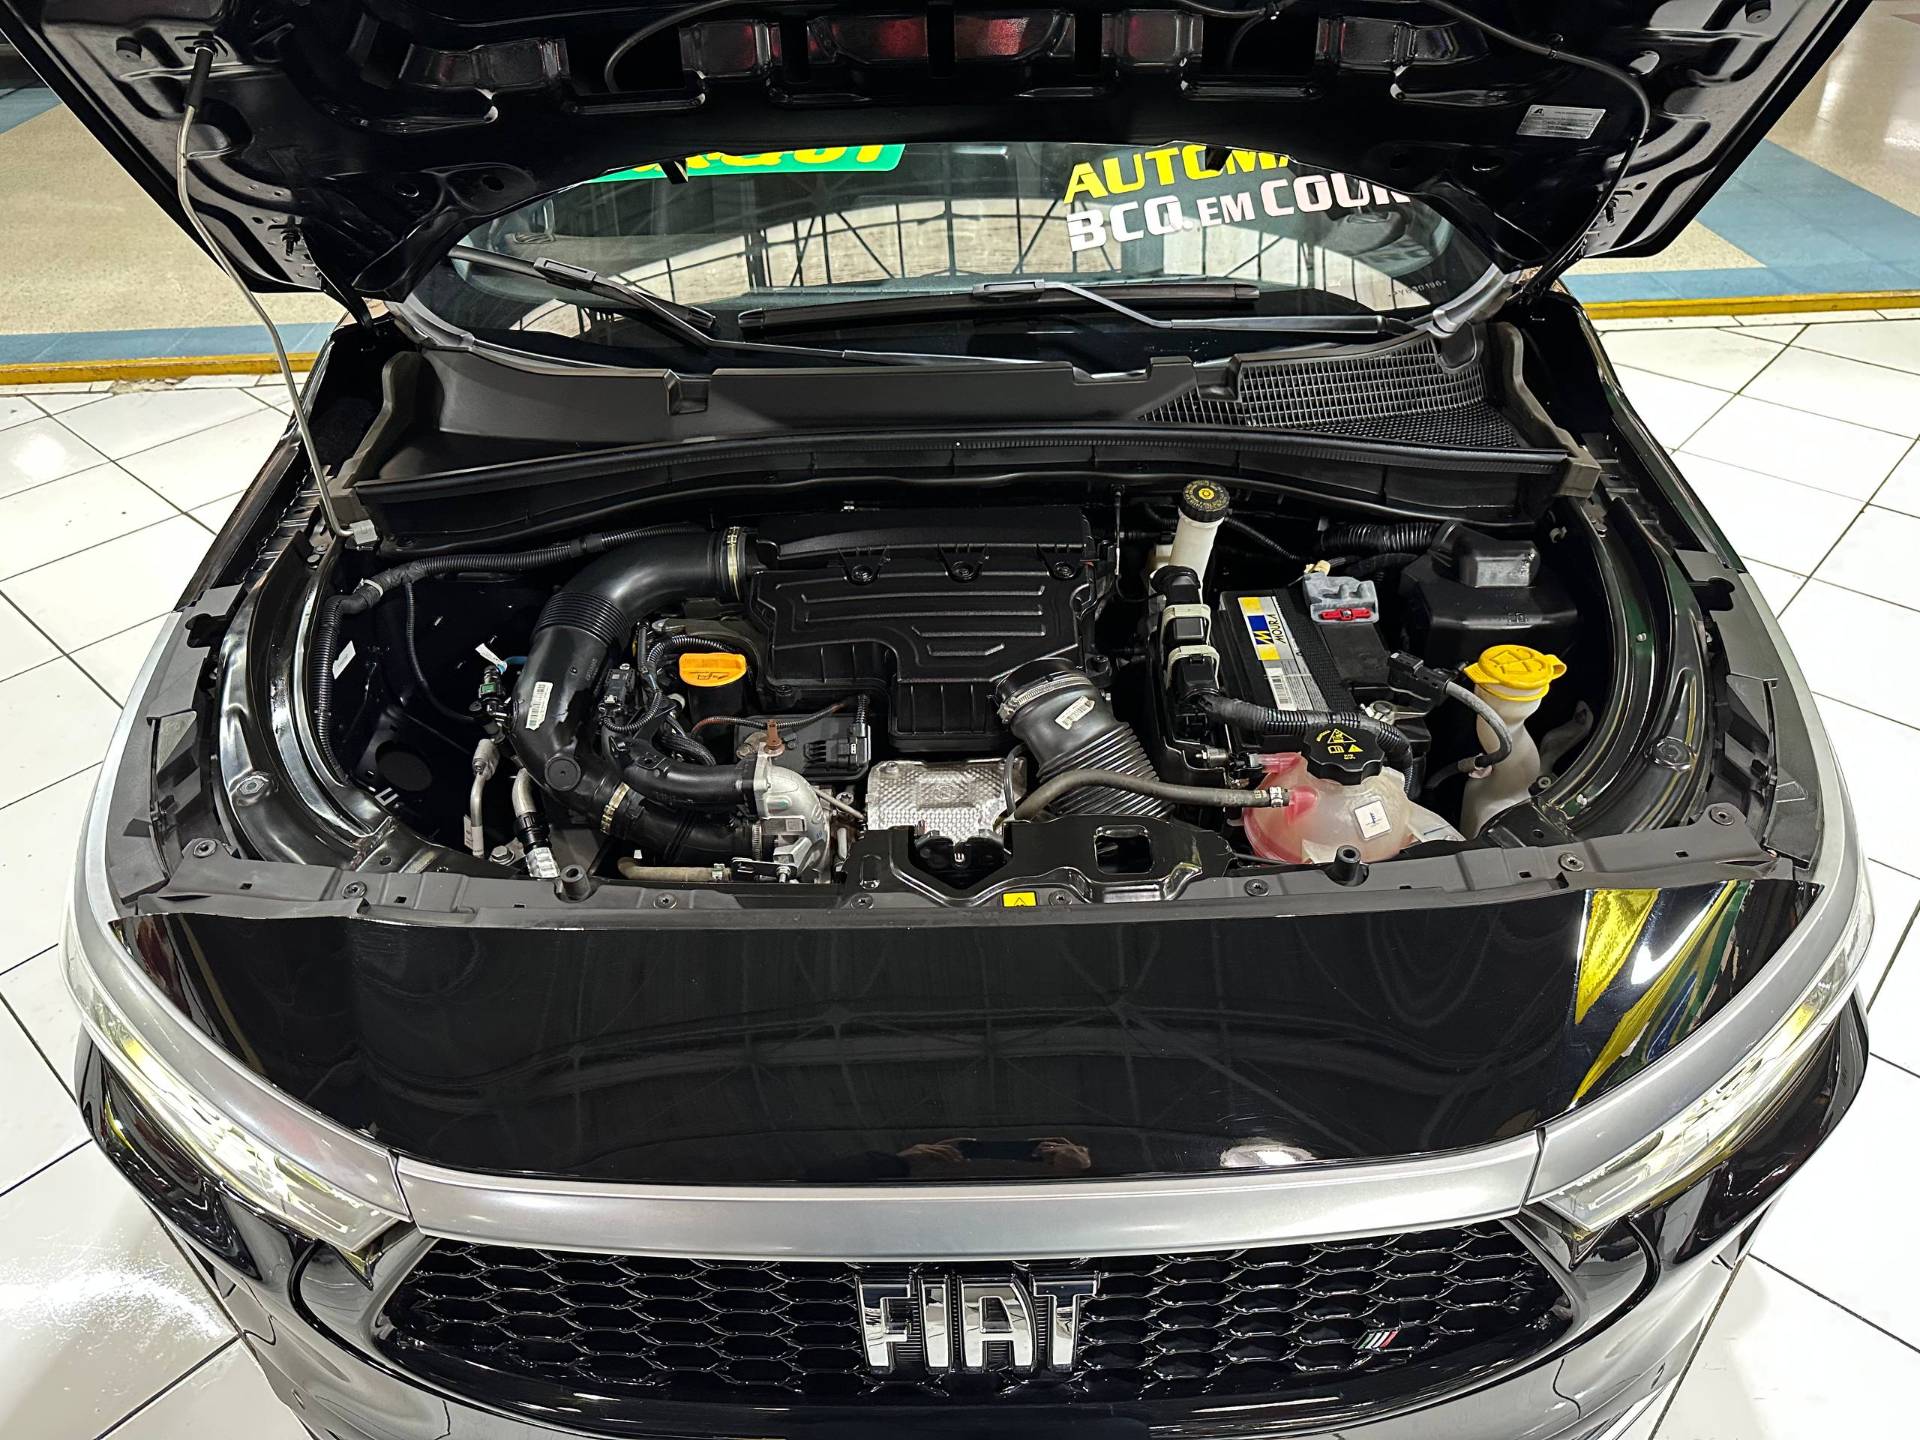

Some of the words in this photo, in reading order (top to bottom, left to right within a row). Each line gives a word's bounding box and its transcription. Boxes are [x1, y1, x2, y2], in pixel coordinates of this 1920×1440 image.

[1064, 145, 1289, 204] AUTOM
[1197, 192, 1256, 227] EM
[1266, 613, 1287, 644] MOURA
[857, 1278, 1099, 1370] FIAT
